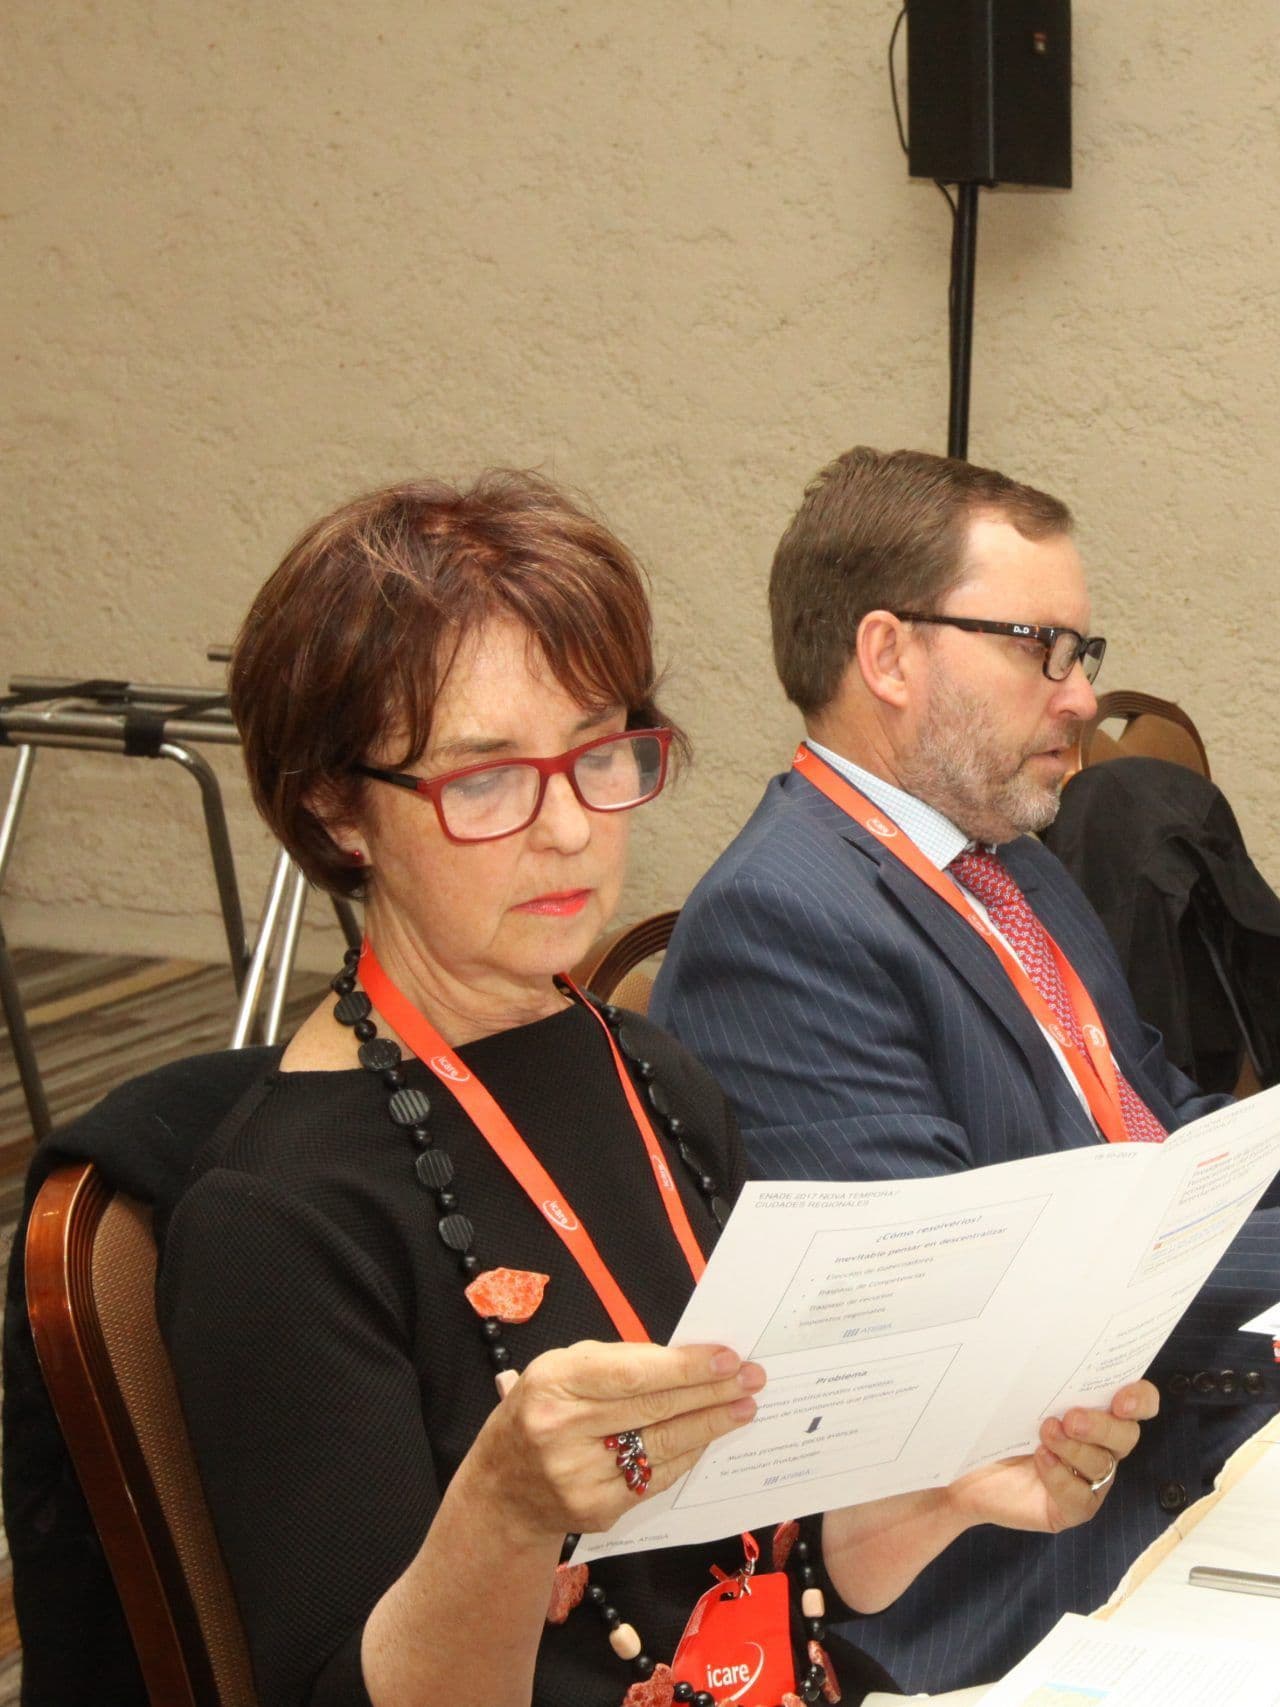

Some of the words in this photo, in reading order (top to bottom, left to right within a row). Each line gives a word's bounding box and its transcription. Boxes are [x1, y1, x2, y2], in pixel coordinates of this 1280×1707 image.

[755, 1201, 805, 1209] CIUDADES
[808, 1200, 870, 1208] REGIONALES
[816, 1371, 868, 1384] Problema
[706, 1663, 750, 1688] icare
